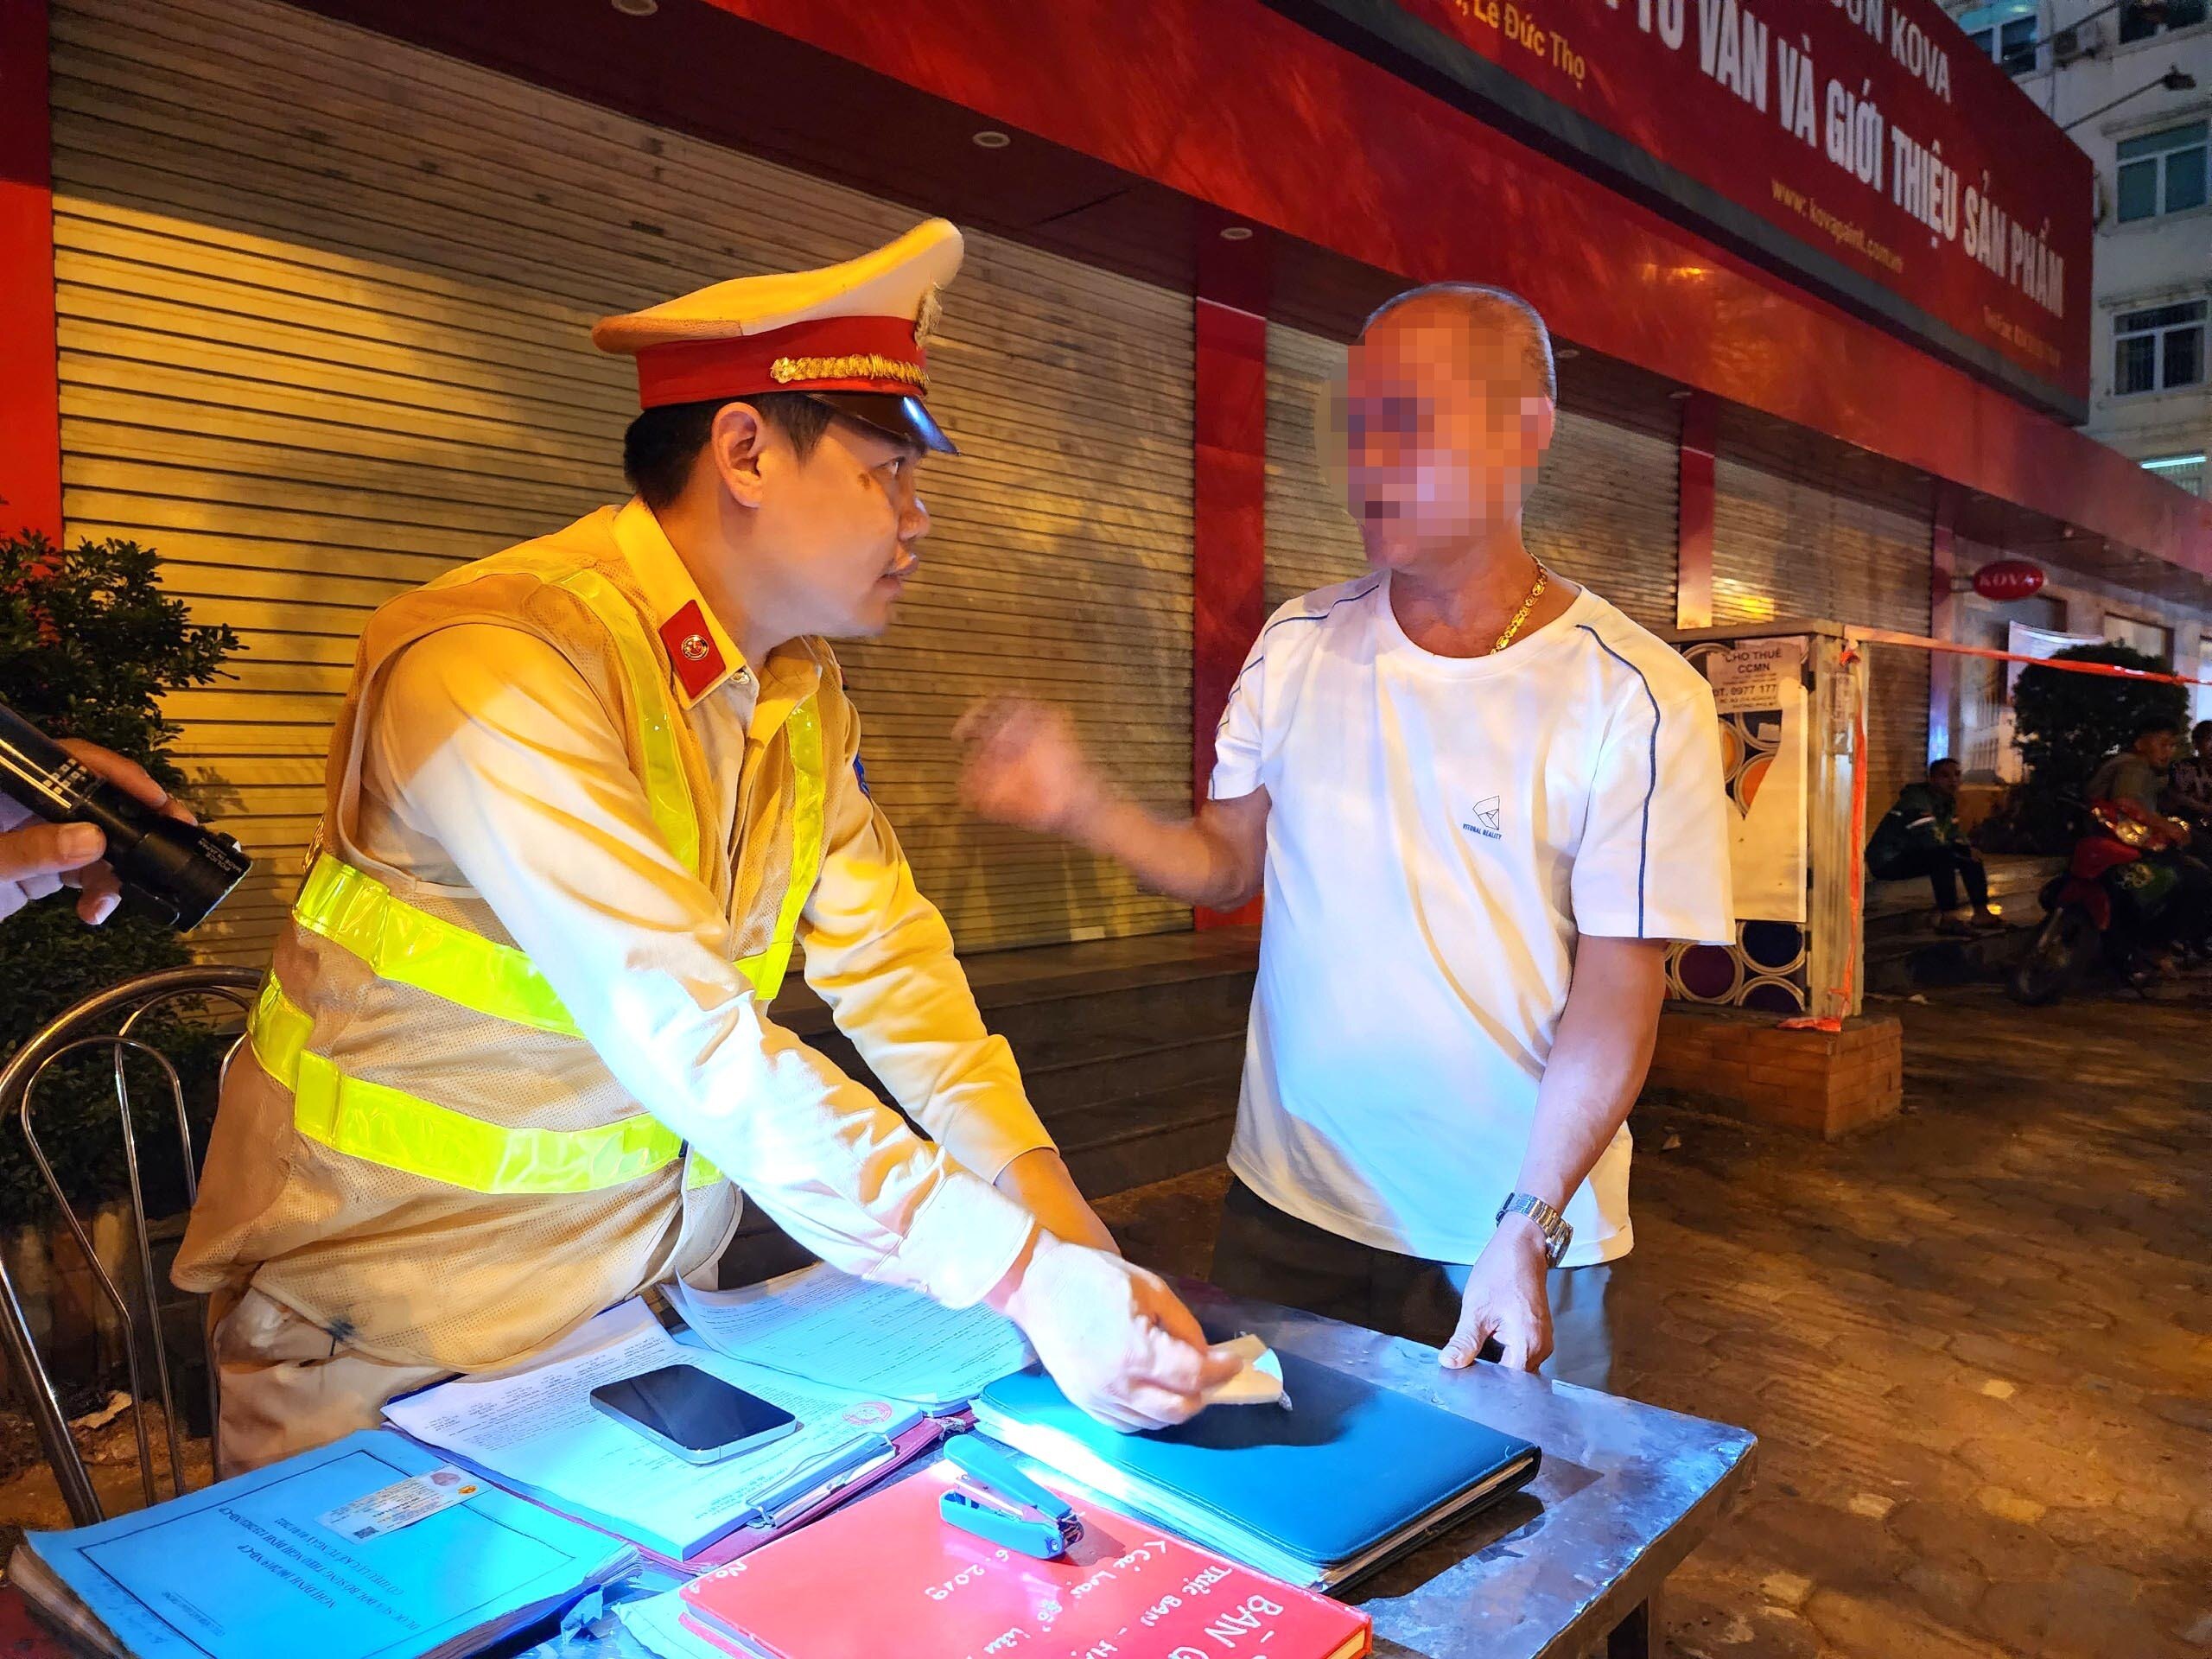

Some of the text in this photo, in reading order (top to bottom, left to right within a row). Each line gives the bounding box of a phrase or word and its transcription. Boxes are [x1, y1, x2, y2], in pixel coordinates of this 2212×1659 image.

[1503, 3, 1546, 57] Đức
[1549, 30, 1586, 90] Thọ
[1891, 7, 1951, 104] KOVA
[1777, 33, 1816, 148] VÀ
[1826, 78, 1884, 193] GIỚI
[1891, 124, 1957, 249] THIỆU
[1963, 169, 2006, 278] SẢN
[206, 851, 231, 871] POLICE
[1141, 1595, 1182, 1627] BAN
